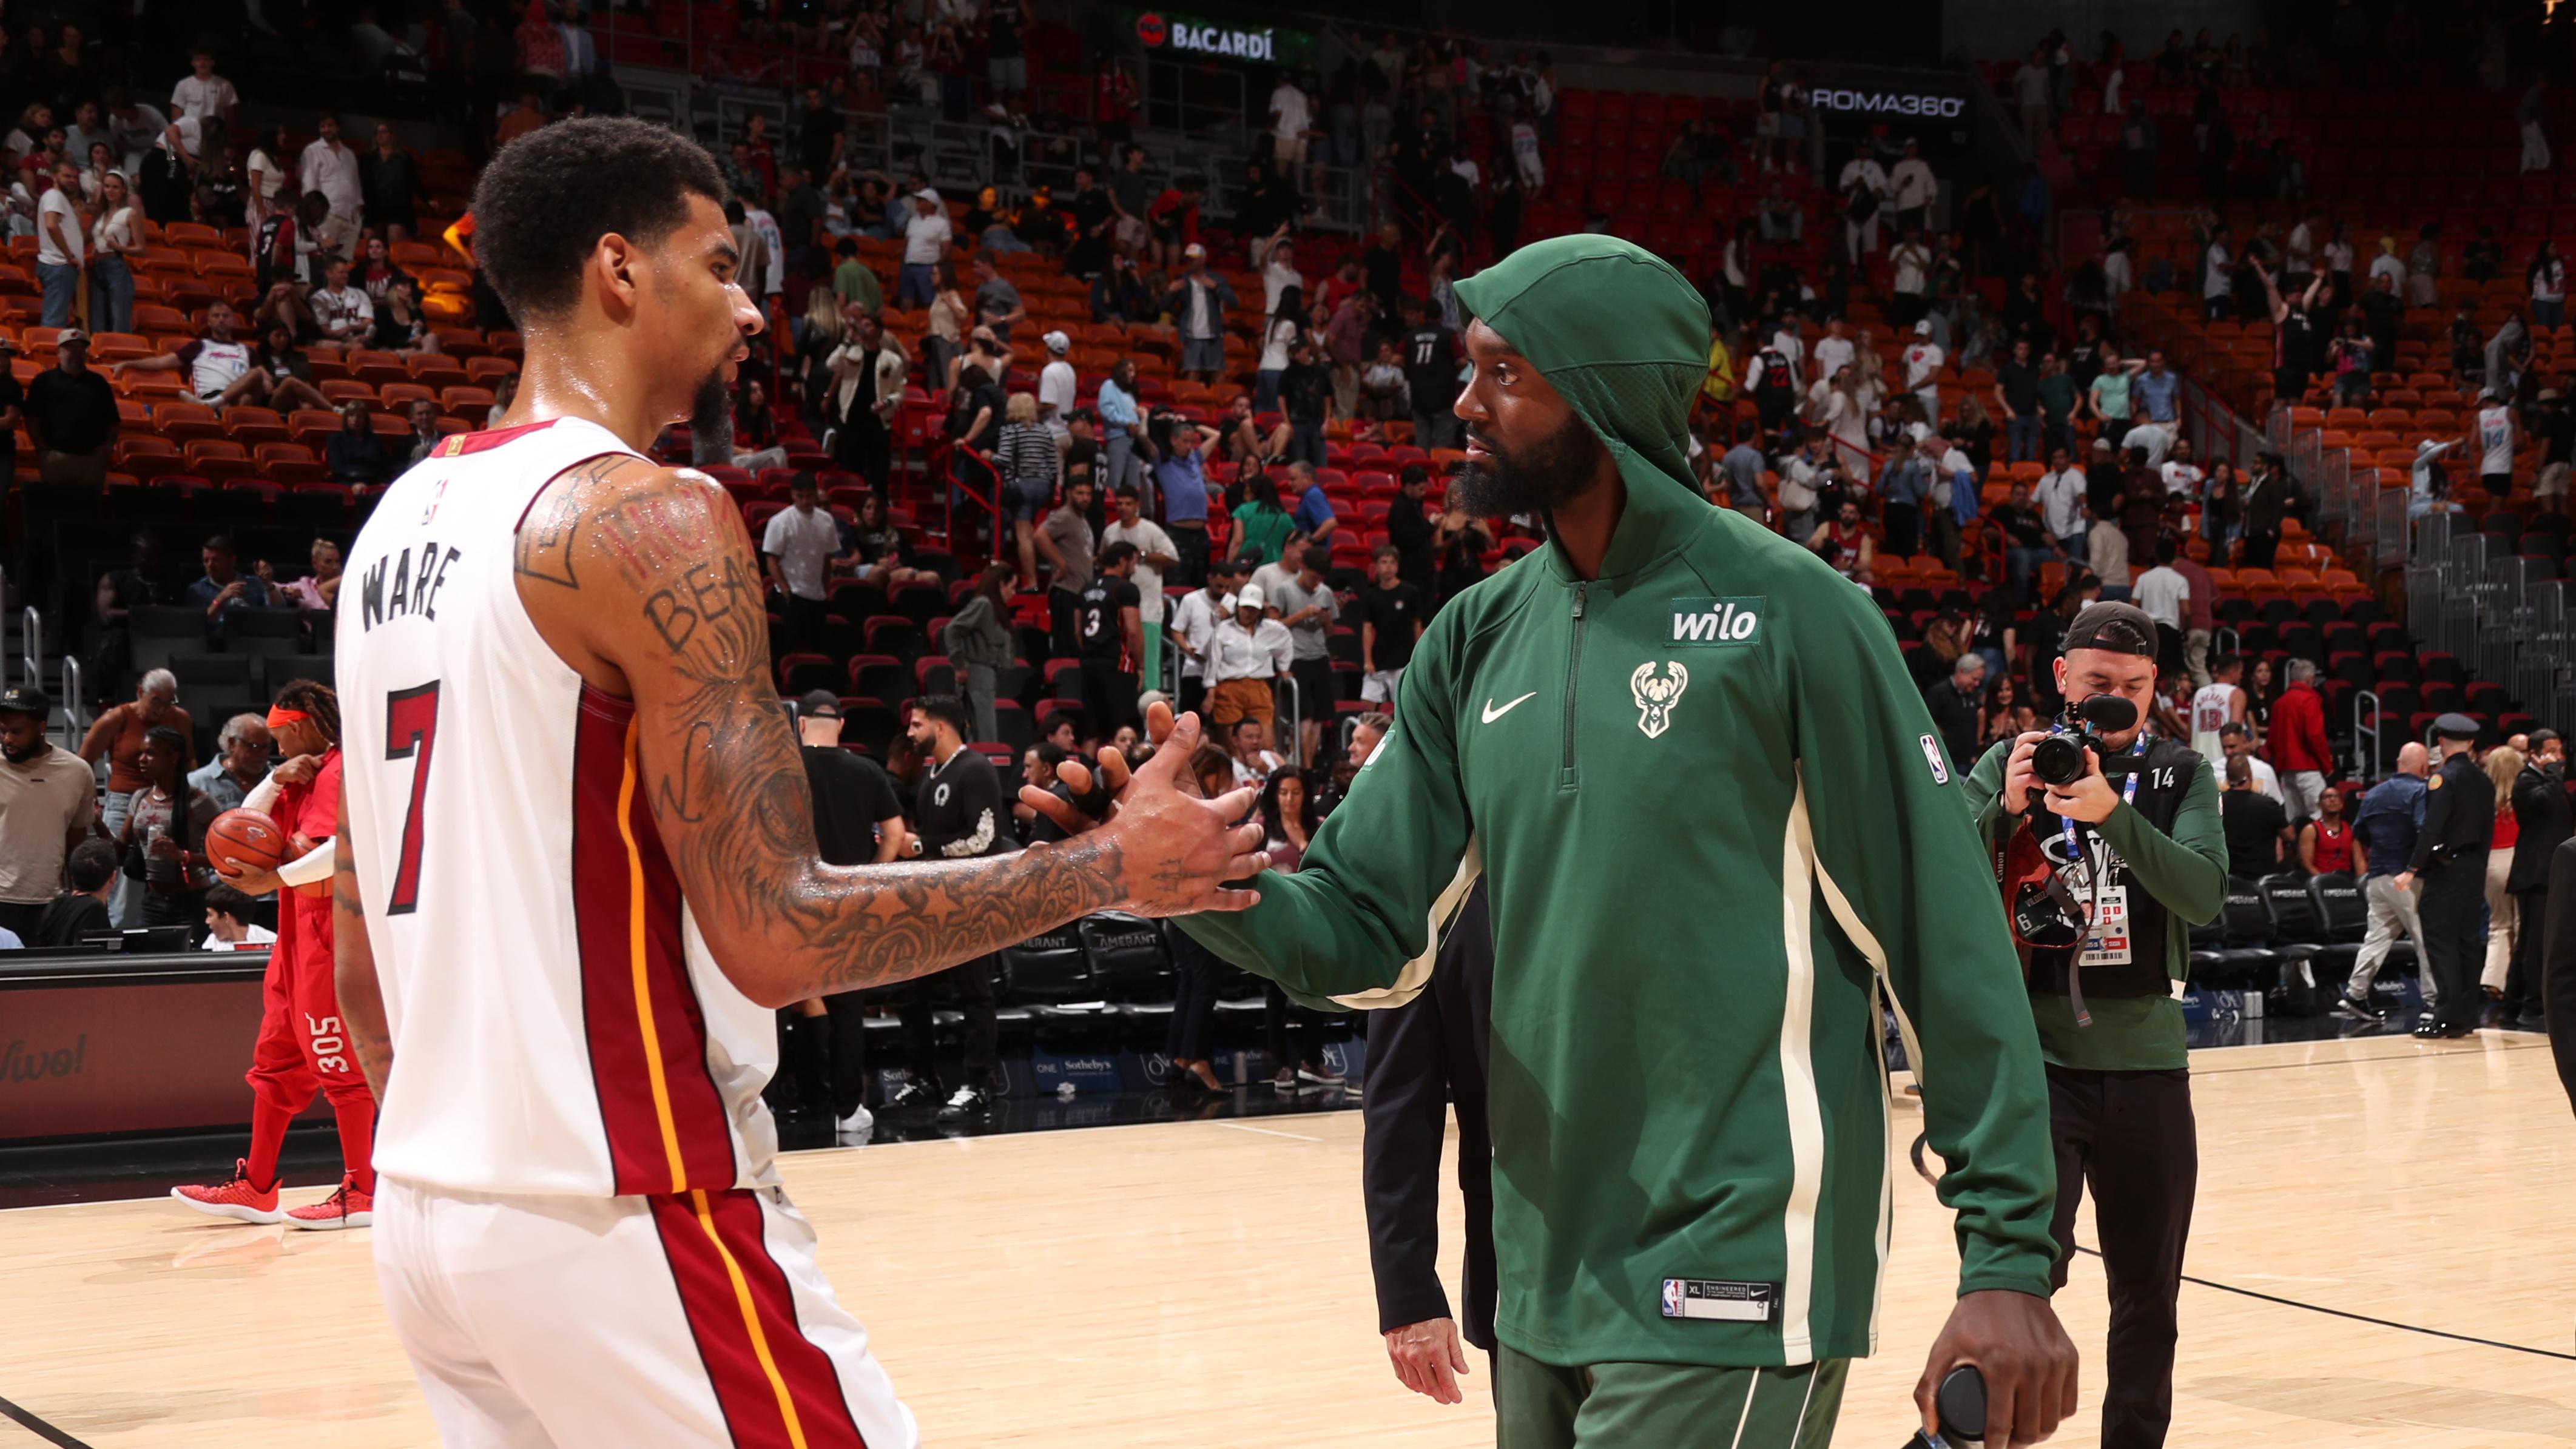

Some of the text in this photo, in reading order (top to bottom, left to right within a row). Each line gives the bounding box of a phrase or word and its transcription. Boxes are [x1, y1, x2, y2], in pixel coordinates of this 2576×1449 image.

[1172, 22, 1273, 61] BACARDÍ
[1415, 342, 1434, 365] 11
[362, 542, 461, 633] WARE
[1084, 608, 1101, 637] 3
[1673, 603, 1757, 640] wilo
[2199, 708, 2222, 733] 13
[2151, 766, 2175, 790] 14
[385, 679, 441, 916] 7
[2025, 890, 2048, 907] VILDOZ
[2016, 913, 2032, 932] 6
[1099, 933, 1157, 947] AMERANT
[305, 1011, 350, 1074] 305
[1036, 1059, 1111, 1074] ONE Sotheby's
[1688, 1285, 1701, 1294] XL
